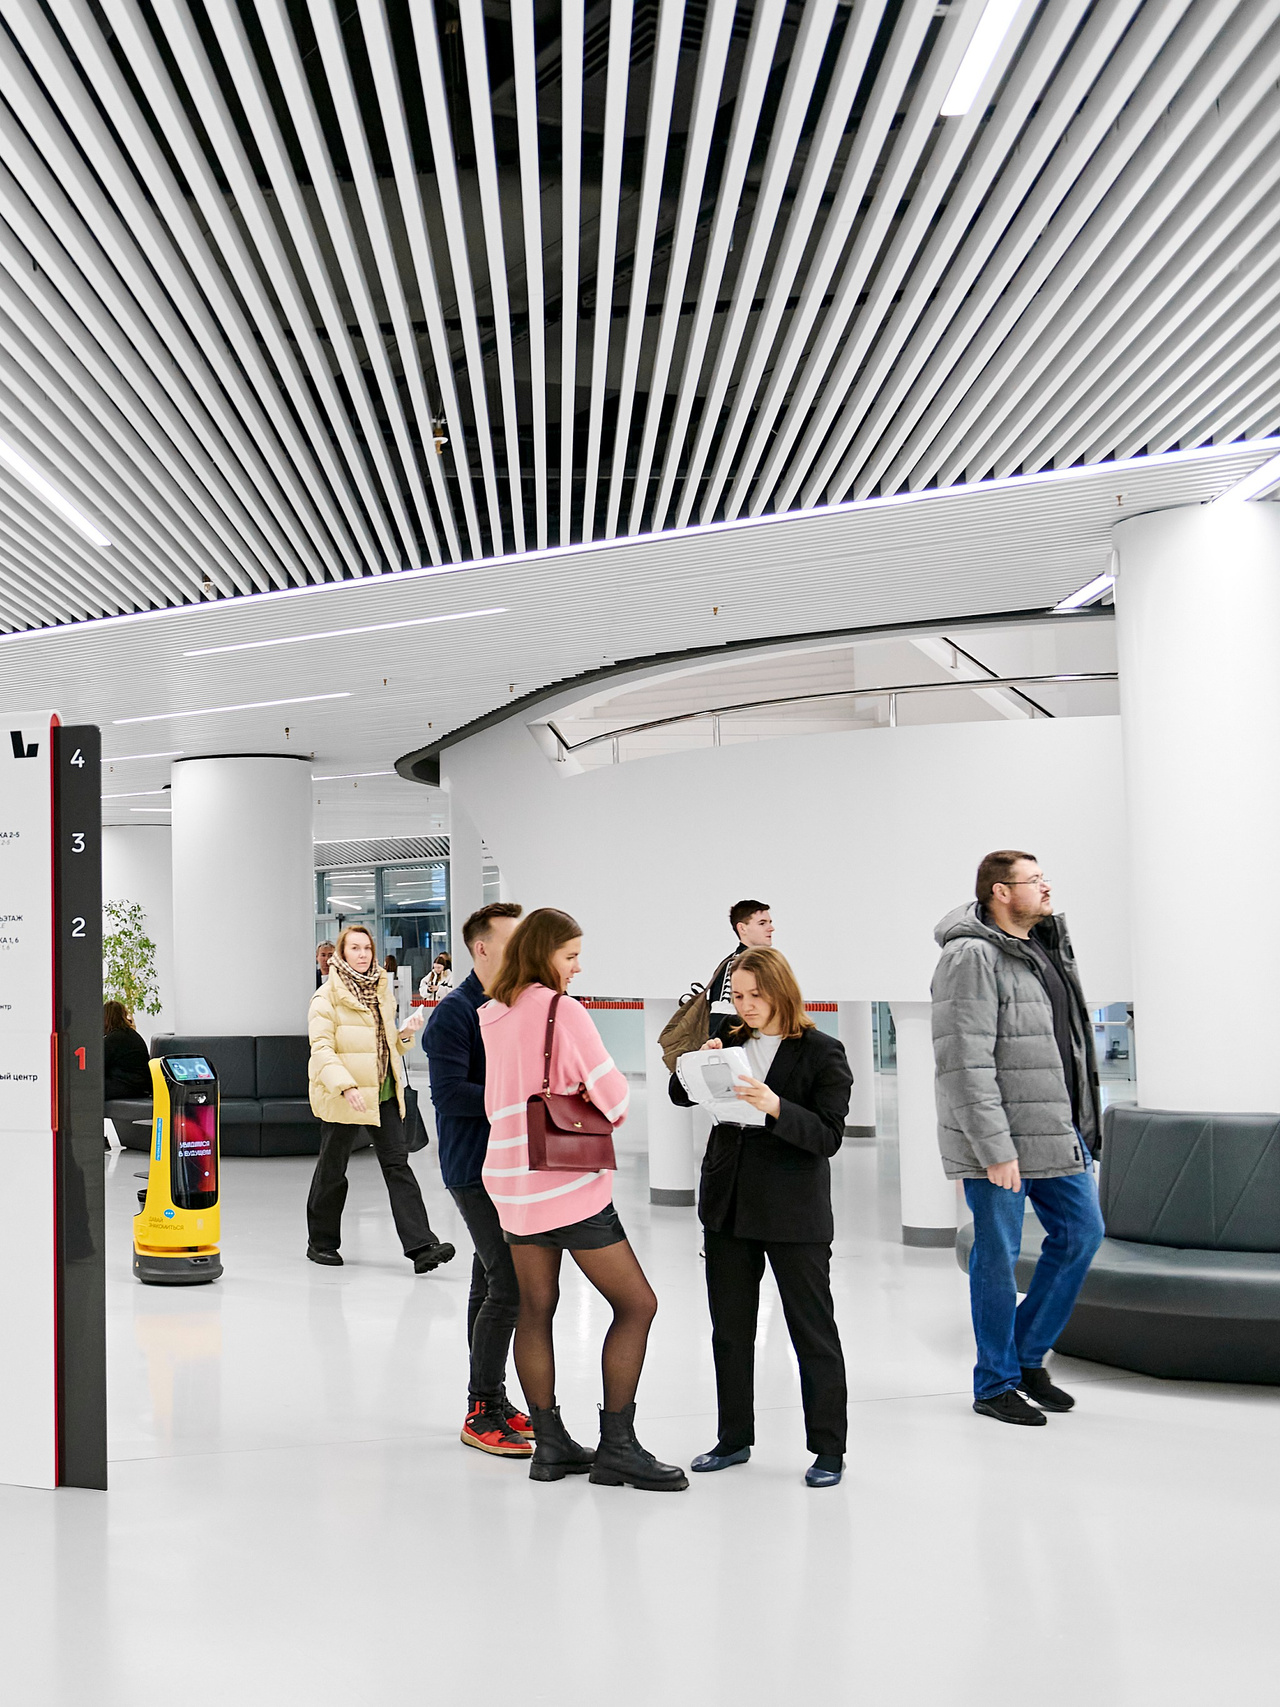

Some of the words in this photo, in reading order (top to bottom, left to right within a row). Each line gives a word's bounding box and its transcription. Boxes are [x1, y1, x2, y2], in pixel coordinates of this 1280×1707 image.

[70, 748, 85, 768] 4
[71, 832, 85, 853] 3
[71, 916, 86, 938] 2
[73, 1047, 86, 1070] 1
[13, 1074, 38, 1082] центр
